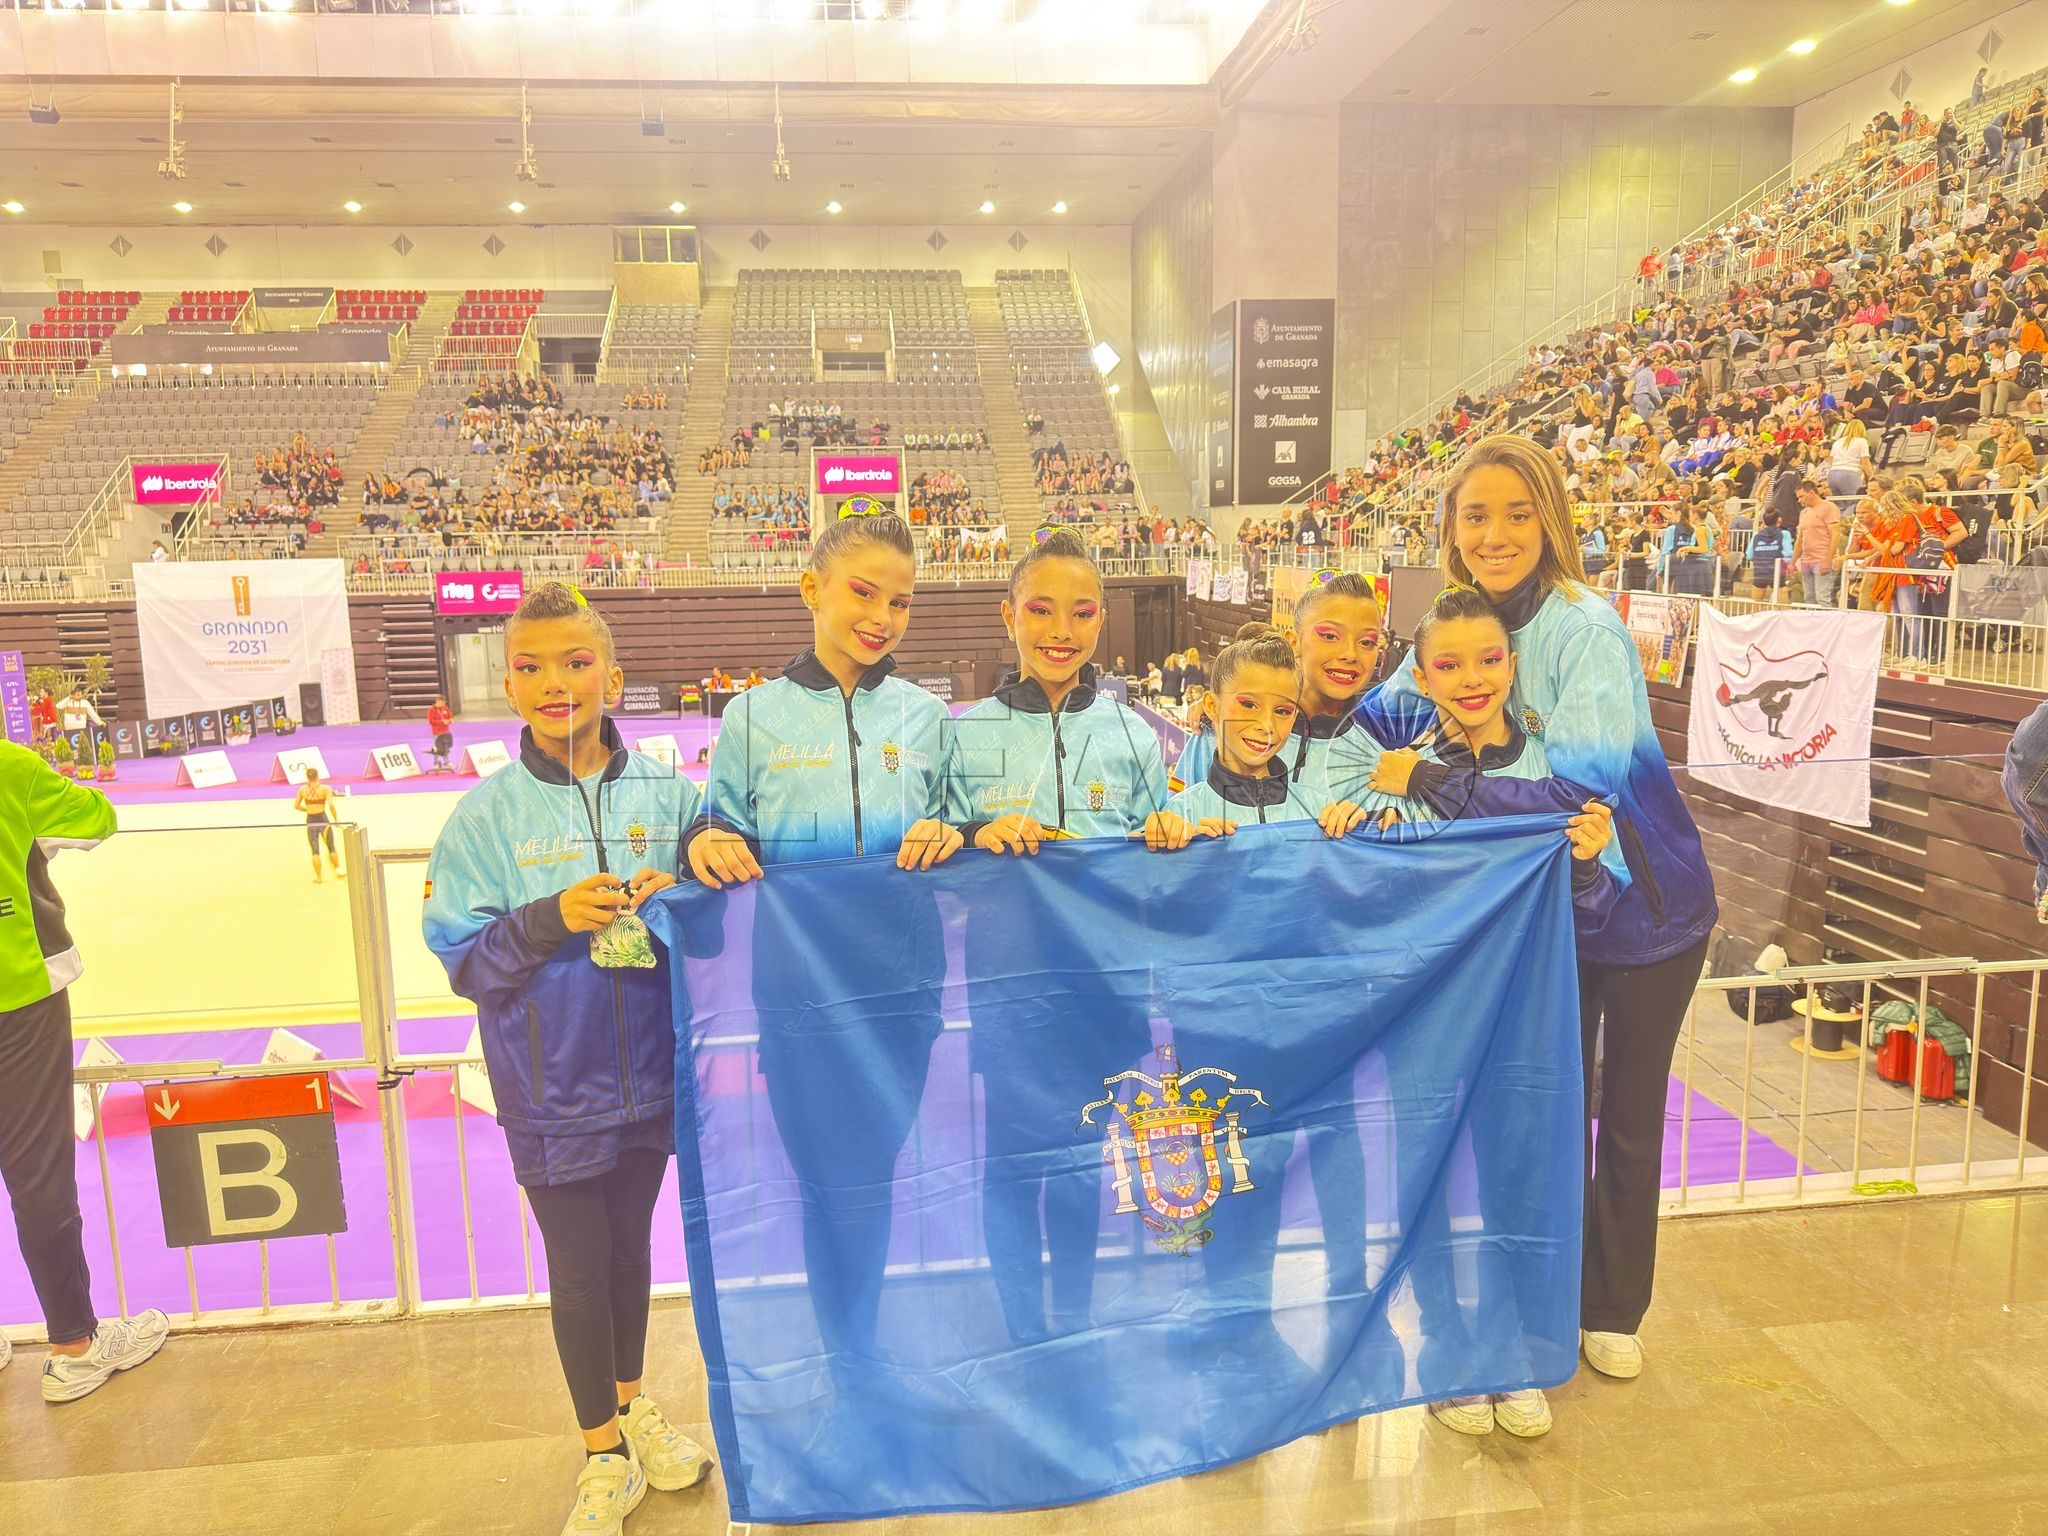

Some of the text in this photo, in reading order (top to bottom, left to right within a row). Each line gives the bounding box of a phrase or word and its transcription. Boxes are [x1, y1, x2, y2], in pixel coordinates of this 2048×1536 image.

[1266, 358, 1319, 370] emasagra
[1292, 385, 1320, 394] RURAL
[1269, 414, 1319, 428] Alhambra
[1301, 531, 1316, 544] 22
[202, 620, 289, 636] GRANADA
[227, 640, 268, 655] 2031
[623, 685, 659, 694] FEDERACIÓN
[623, 694, 660, 702] ANDALUZA
[623, 701, 661, 711] GIMNASIA
[769, 741, 835, 763] MELILLA
[381, 752, 412, 769] rfeg
[980, 782, 1037, 803] MELILLA
[515, 832, 584, 861] MELILLA
[1188, 1068, 1228, 1079] PARENTEM
[305, 1078, 324, 1110] 1
[197, 1129, 298, 1236] B
